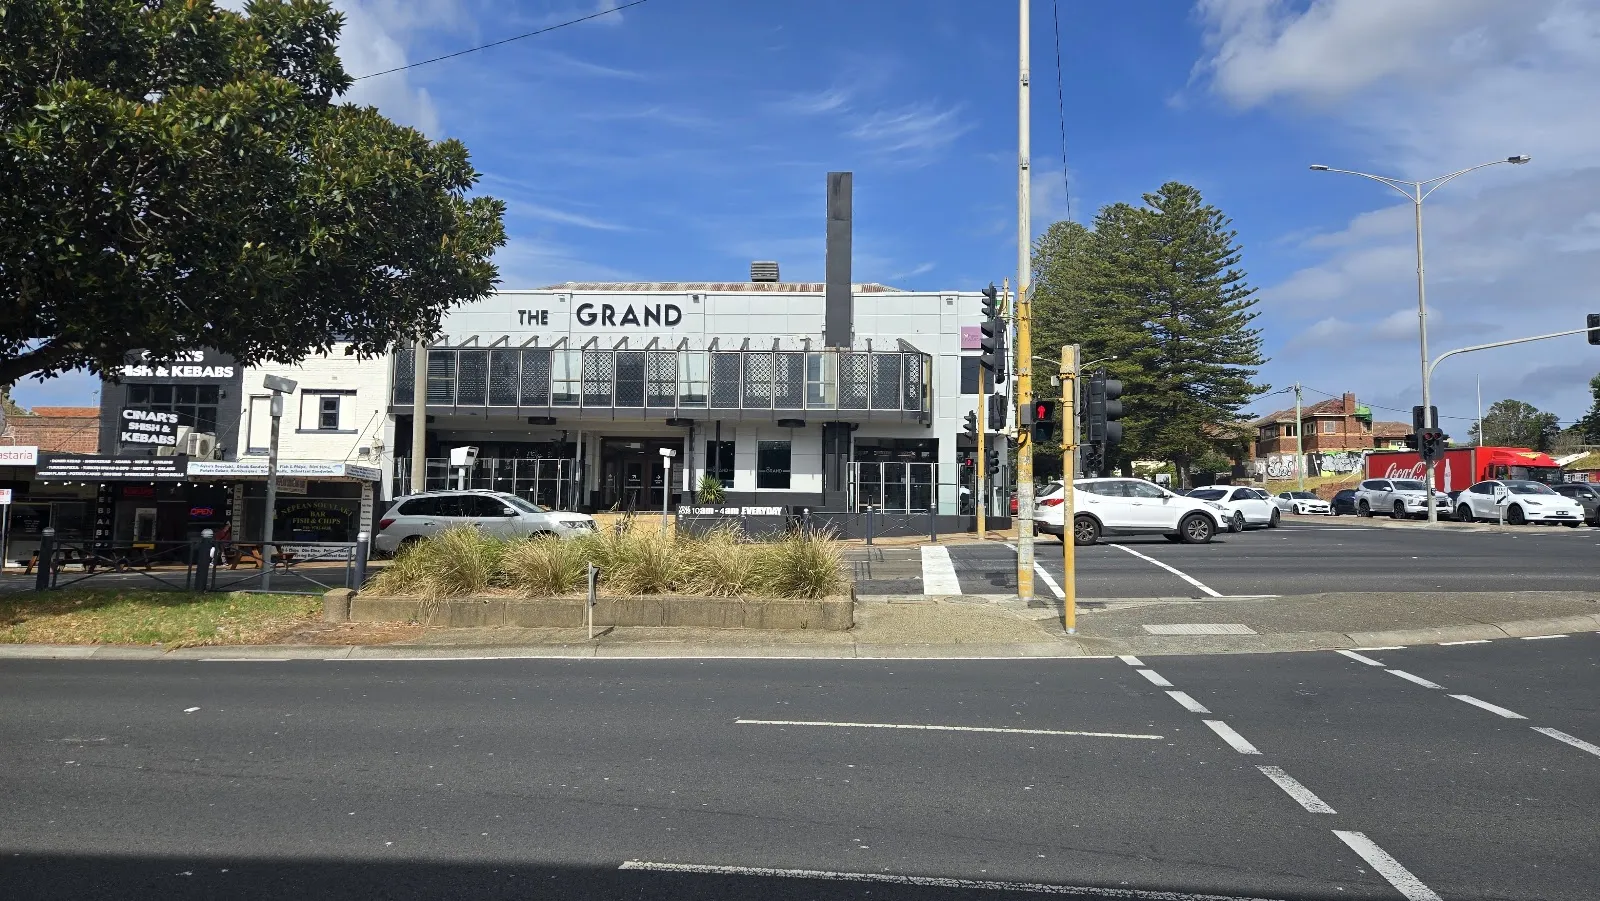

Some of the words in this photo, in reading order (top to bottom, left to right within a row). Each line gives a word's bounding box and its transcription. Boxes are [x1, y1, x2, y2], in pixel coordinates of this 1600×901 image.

[517, 309, 549, 326] THE
[576, 302, 682, 327] GRAND
[155, 365, 169, 377] &
[171, 366, 234, 378] KEBABS
[122, 409, 178, 424] CINAR'S
[128, 421, 160, 432] SHISH
[161, 423, 171, 433] &
[121, 432, 176, 446] KEBABS
[692, 507, 714, 515] 10am
[719, 507, 739, 515] 4am
[741, 506, 783, 516] EVERYDAY
[317, 517, 341, 525] CHIPS
